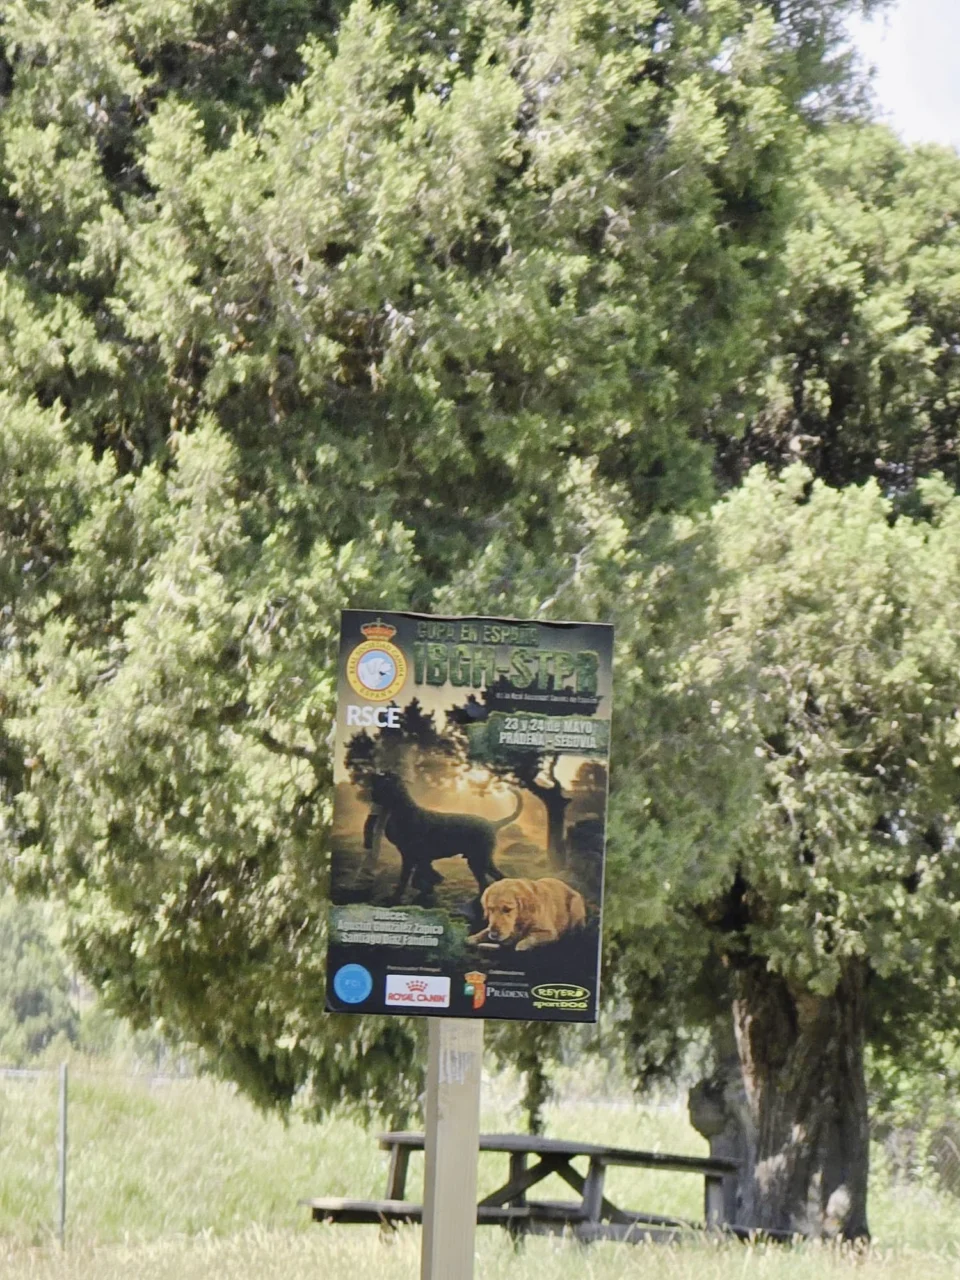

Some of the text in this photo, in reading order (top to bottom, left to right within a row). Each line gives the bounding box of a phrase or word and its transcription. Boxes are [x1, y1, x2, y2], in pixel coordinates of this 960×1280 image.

[347, 705, 401, 728] RSCE
[505, 718, 519, 730] 23
[530, 719, 544, 731] 24
[563, 721, 593, 733] MAYO
[388, 992, 445, 1003] ROYAL CANIN
